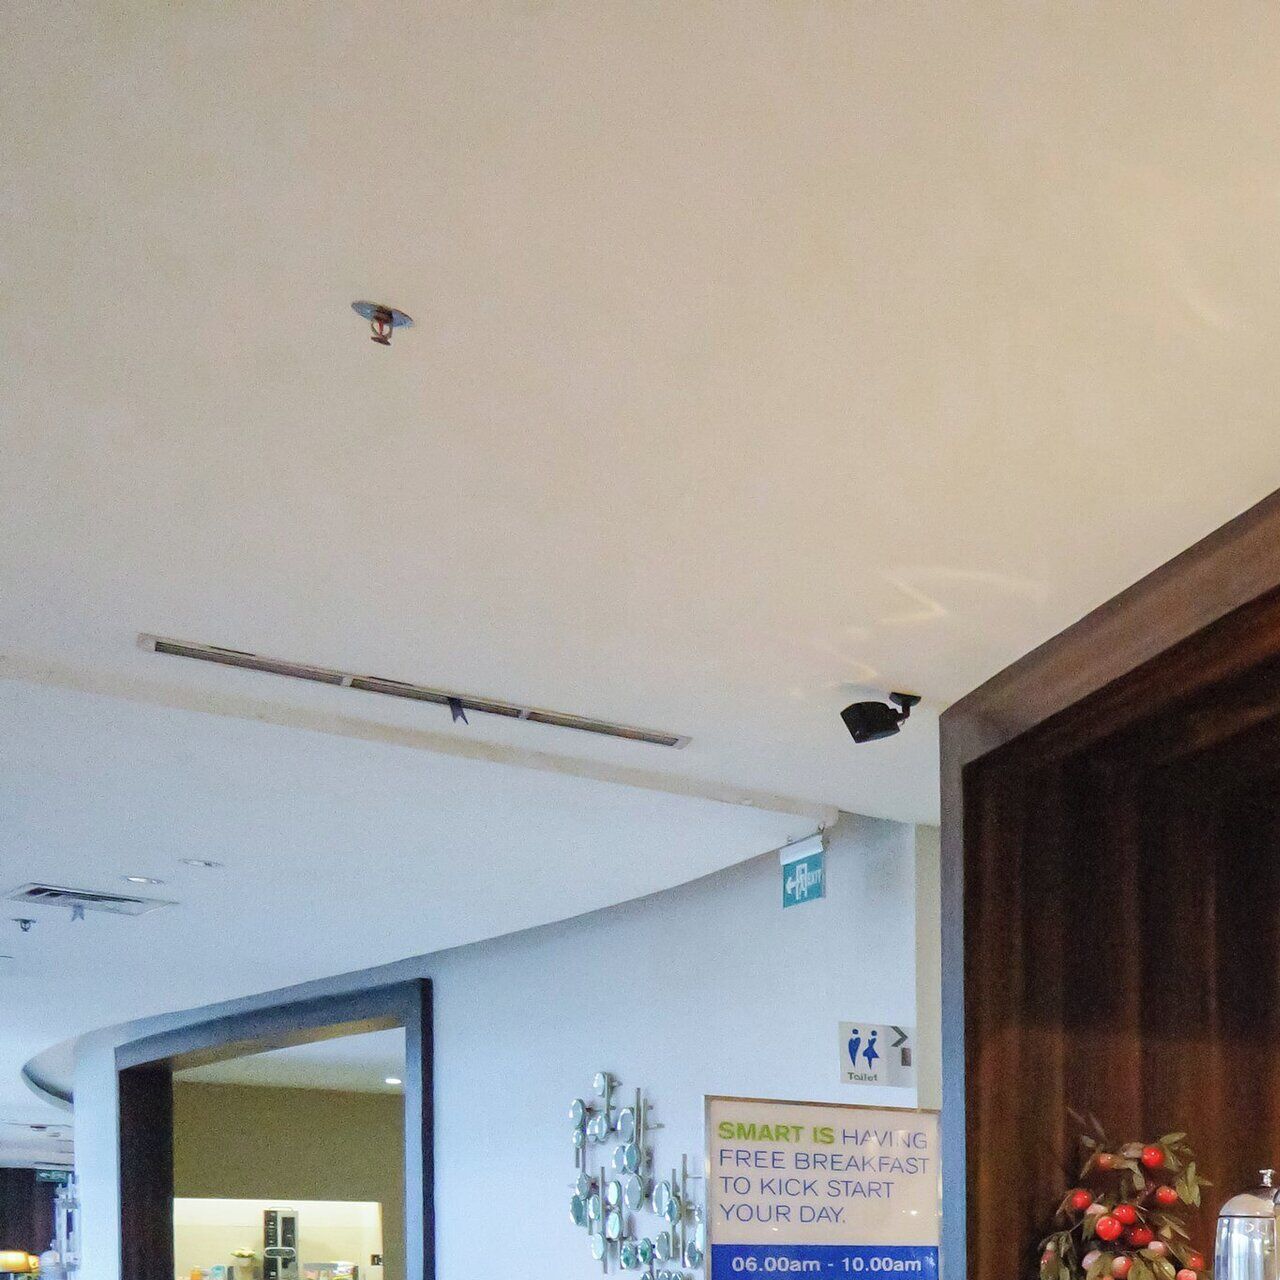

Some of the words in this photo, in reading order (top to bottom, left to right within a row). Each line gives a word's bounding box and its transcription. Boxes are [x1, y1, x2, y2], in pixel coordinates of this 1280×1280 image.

[847, 1071, 878, 1082] Toilet
[718, 1121, 804, 1143] SMART
[813, 1126, 836, 1145] IS
[842, 1128, 928, 1149] HAVING
[719, 1149, 786, 1170] FREE
[795, 1152, 931, 1175] BREAKFAST
[719, 1176, 751, 1195] TO
[760, 1178, 819, 1197] KICK
[827, 1179, 896, 1199] START
[719, 1203, 792, 1223] YOUR
[800, 1204, 846, 1224] DAY.
[731, 1256, 822, 1273] 06.00am
[842, 1256, 923, 1273] 10.00am
